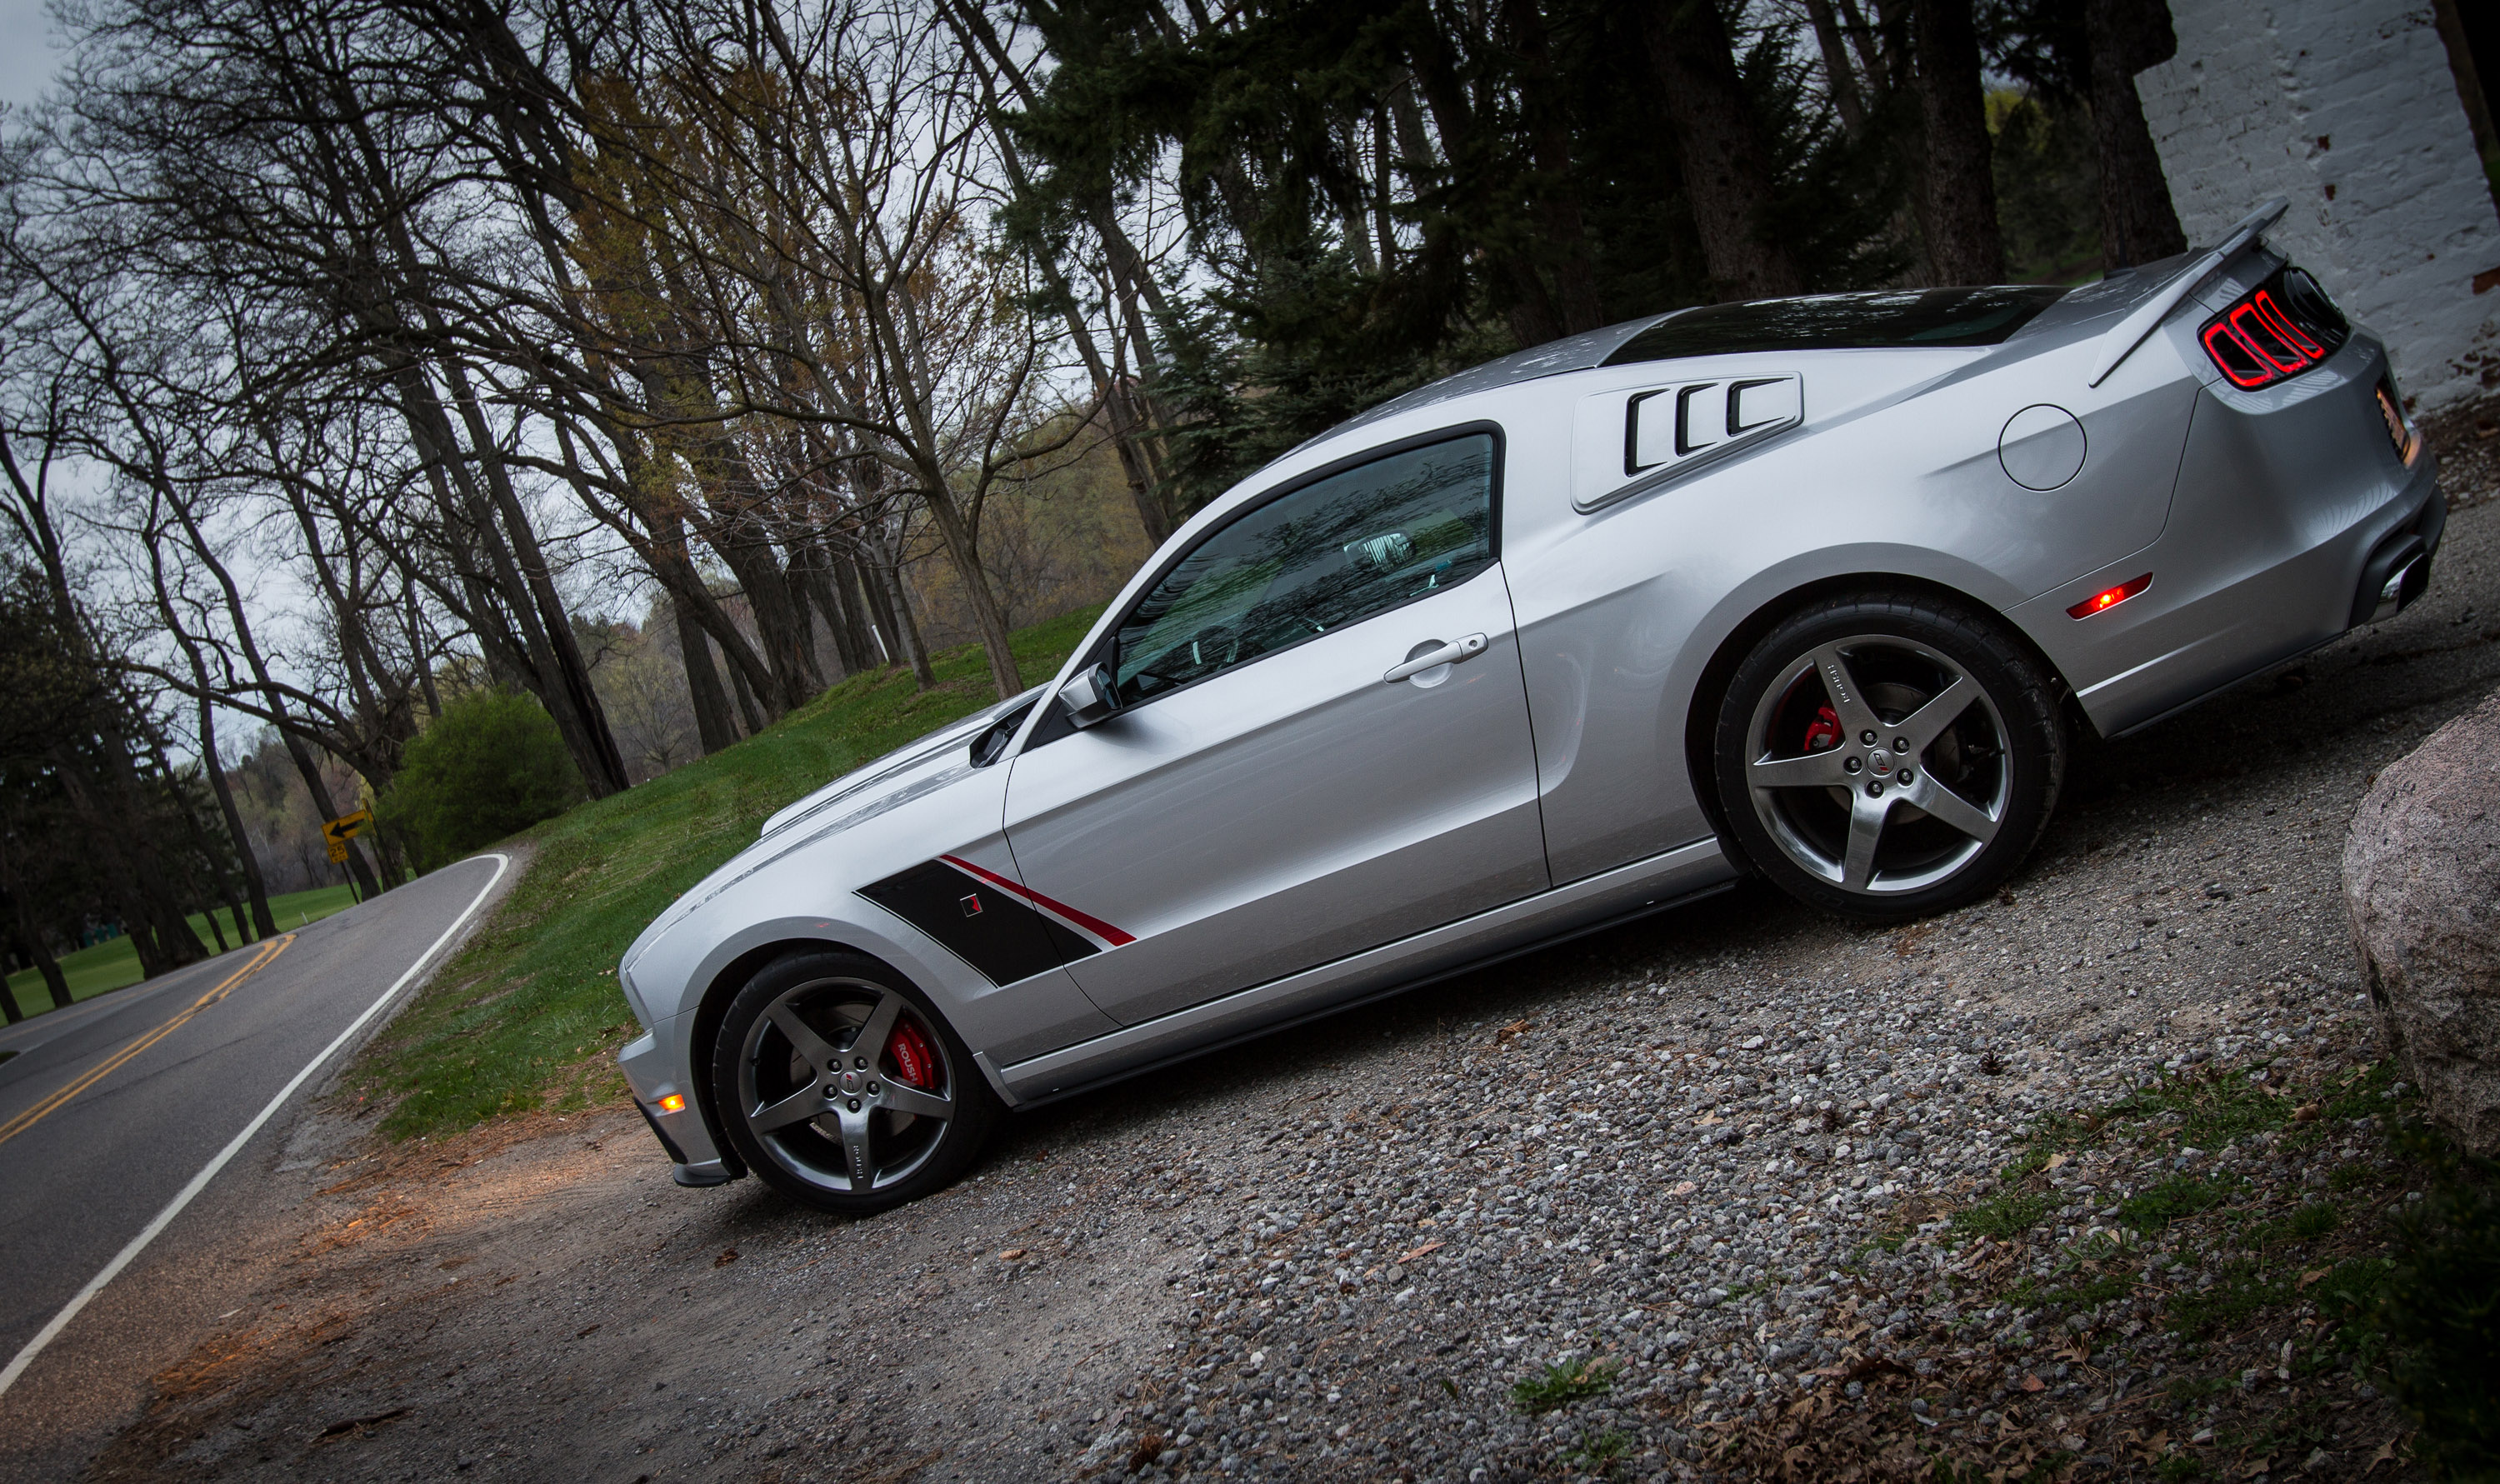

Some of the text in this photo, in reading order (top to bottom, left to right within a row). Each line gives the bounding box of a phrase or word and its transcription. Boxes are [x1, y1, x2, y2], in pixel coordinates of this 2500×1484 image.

[1827, 664, 1851, 703] ROUSH
[330, 846, 345, 857] 25
[898, 1042, 918, 1082] ROUSH
